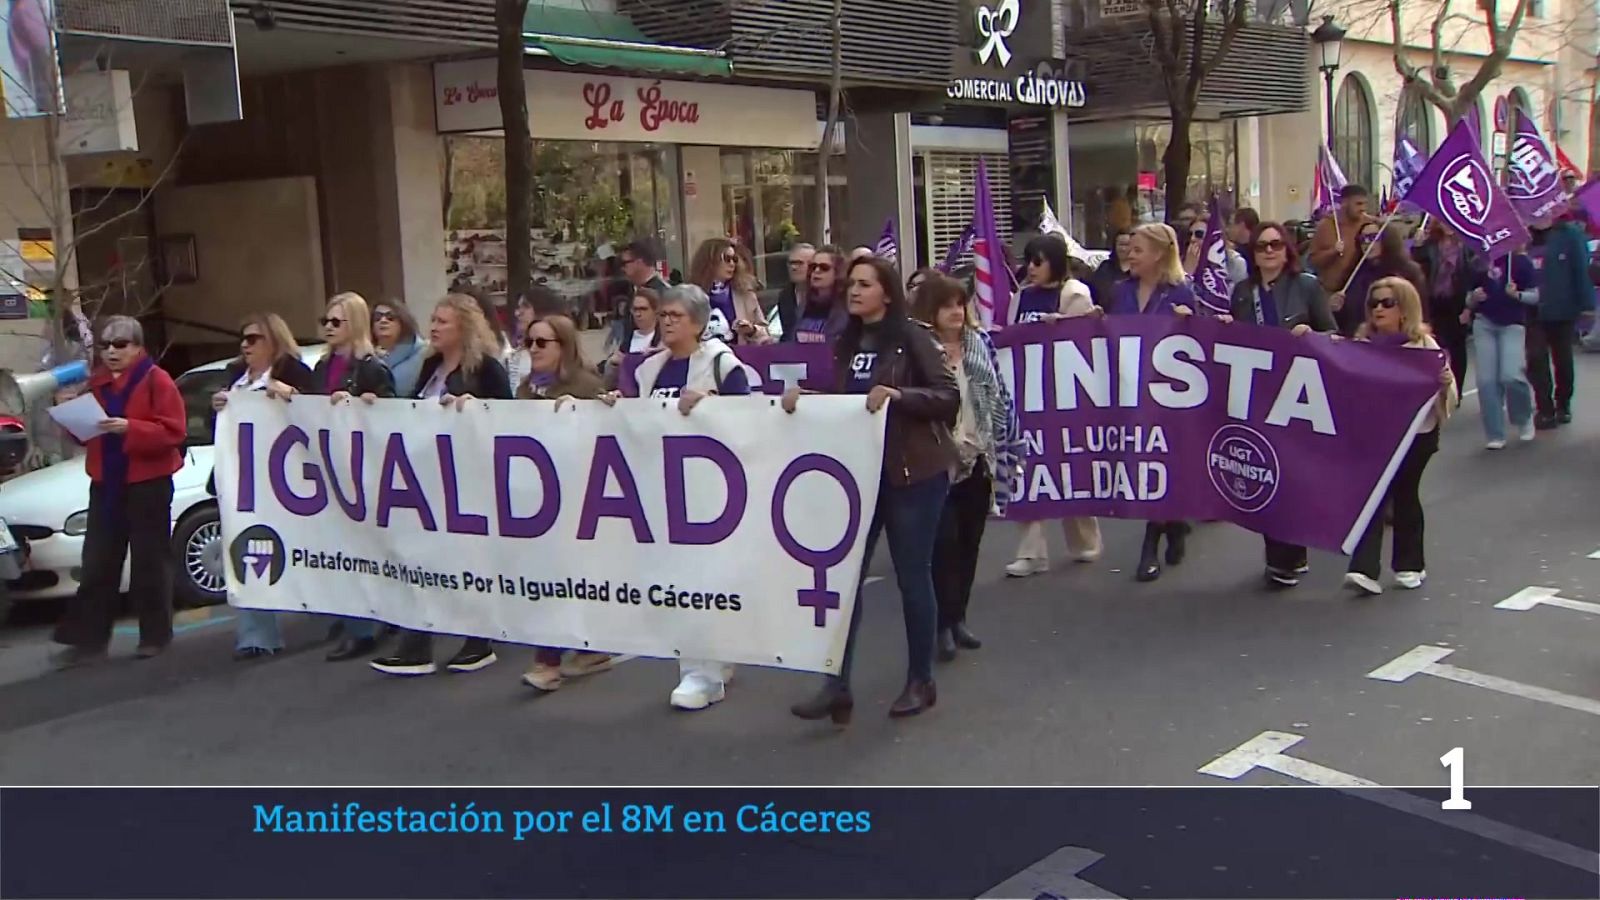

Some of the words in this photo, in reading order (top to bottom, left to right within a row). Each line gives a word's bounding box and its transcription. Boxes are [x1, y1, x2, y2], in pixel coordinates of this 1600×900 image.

[583, 82, 625, 130] La
[638, 80, 699, 132] Época
[947, 79, 1012, 101] COMERCIAL
[1016, 70, 1085, 107] CÁNOVAS
[850, 353, 877, 371] GT
[1024, 429, 1044, 455] N
[1062, 425, 1169, 455] LUCHA
[237, 423, 748, 545] IGUALDAD
[1211, 453, 1275, 485] FEMINISTA
[292, 548, 379, 576] Plataforma
[382, 560, 398, 579] de
[399, 563, 459, 590] Mujeres
[463, 571, 493, 593] Por
[499, 574, 516, 595] la
[520, 576, 611, 601] Igualdad
[616, 583, 642, 605] de
[648, 584, 742, 612] Cáceres
